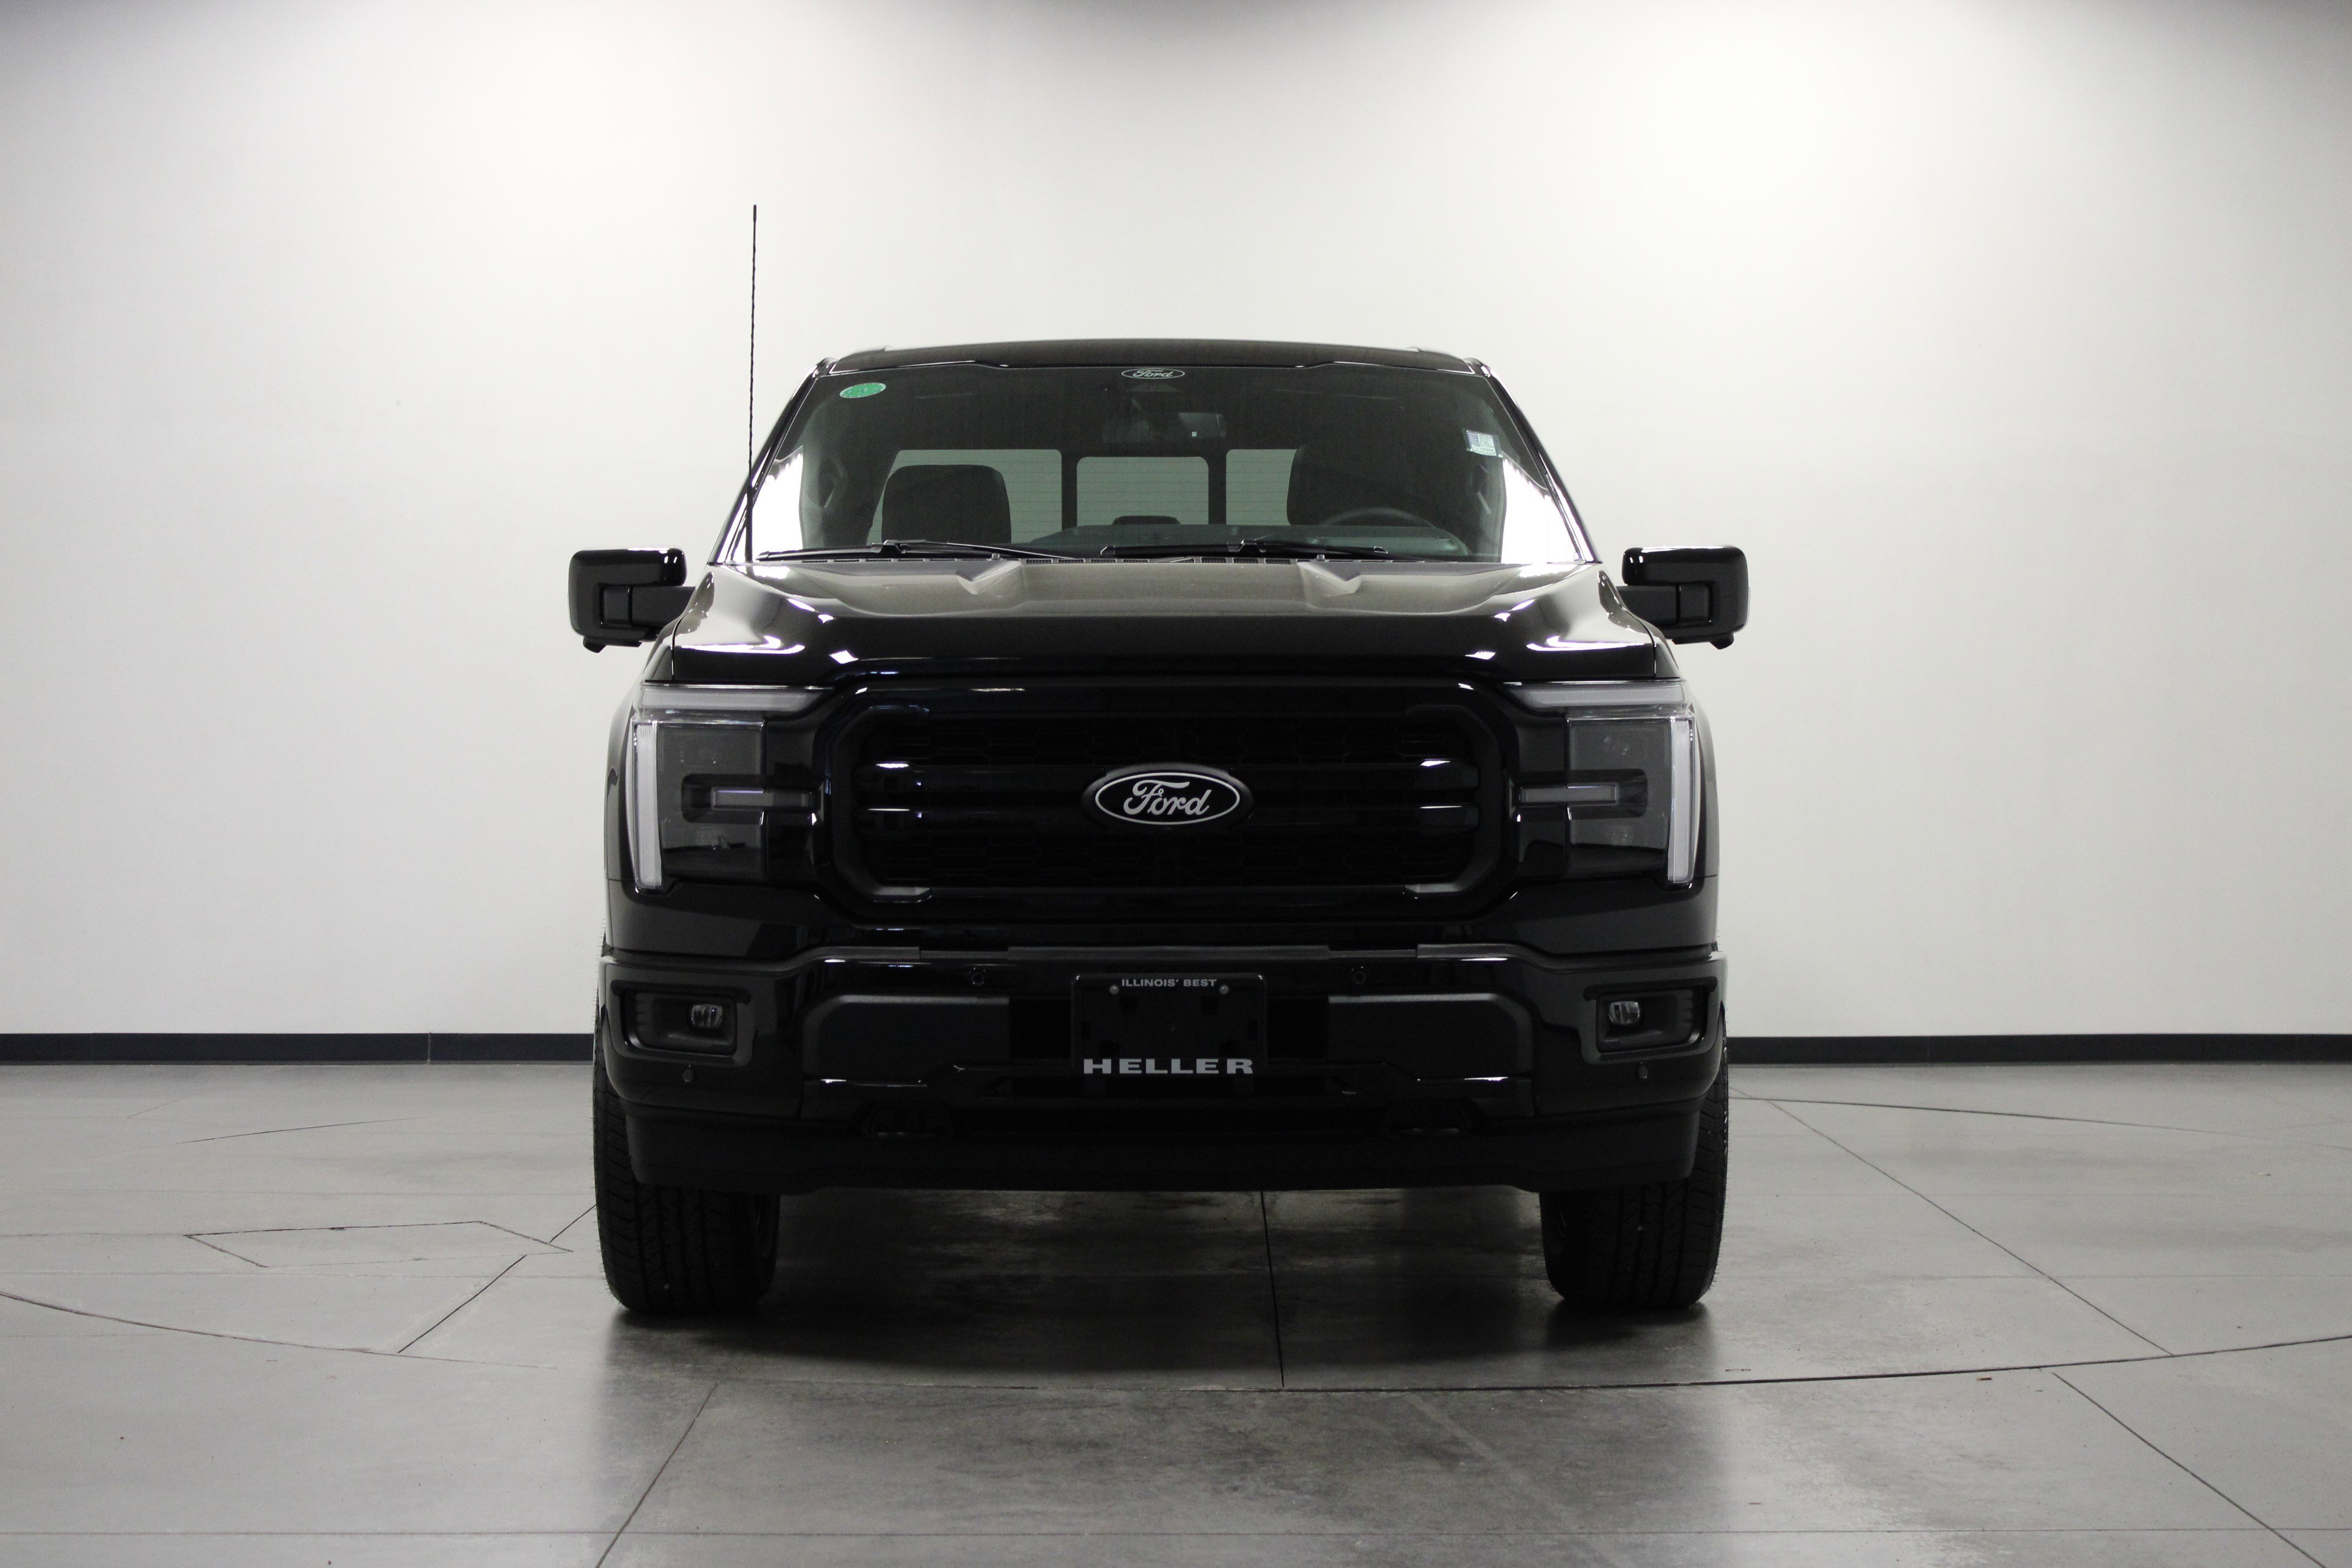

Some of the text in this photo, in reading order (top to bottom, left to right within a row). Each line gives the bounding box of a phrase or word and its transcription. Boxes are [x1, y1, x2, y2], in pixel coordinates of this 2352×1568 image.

[1133, 368, 1174, 377] Ford
[1123, 779, 1211, 815] Ford
[1122, 979, 1217, 987] ILLINOIS' BEST
[1083, 1059, 1253, 1074] HELLER
